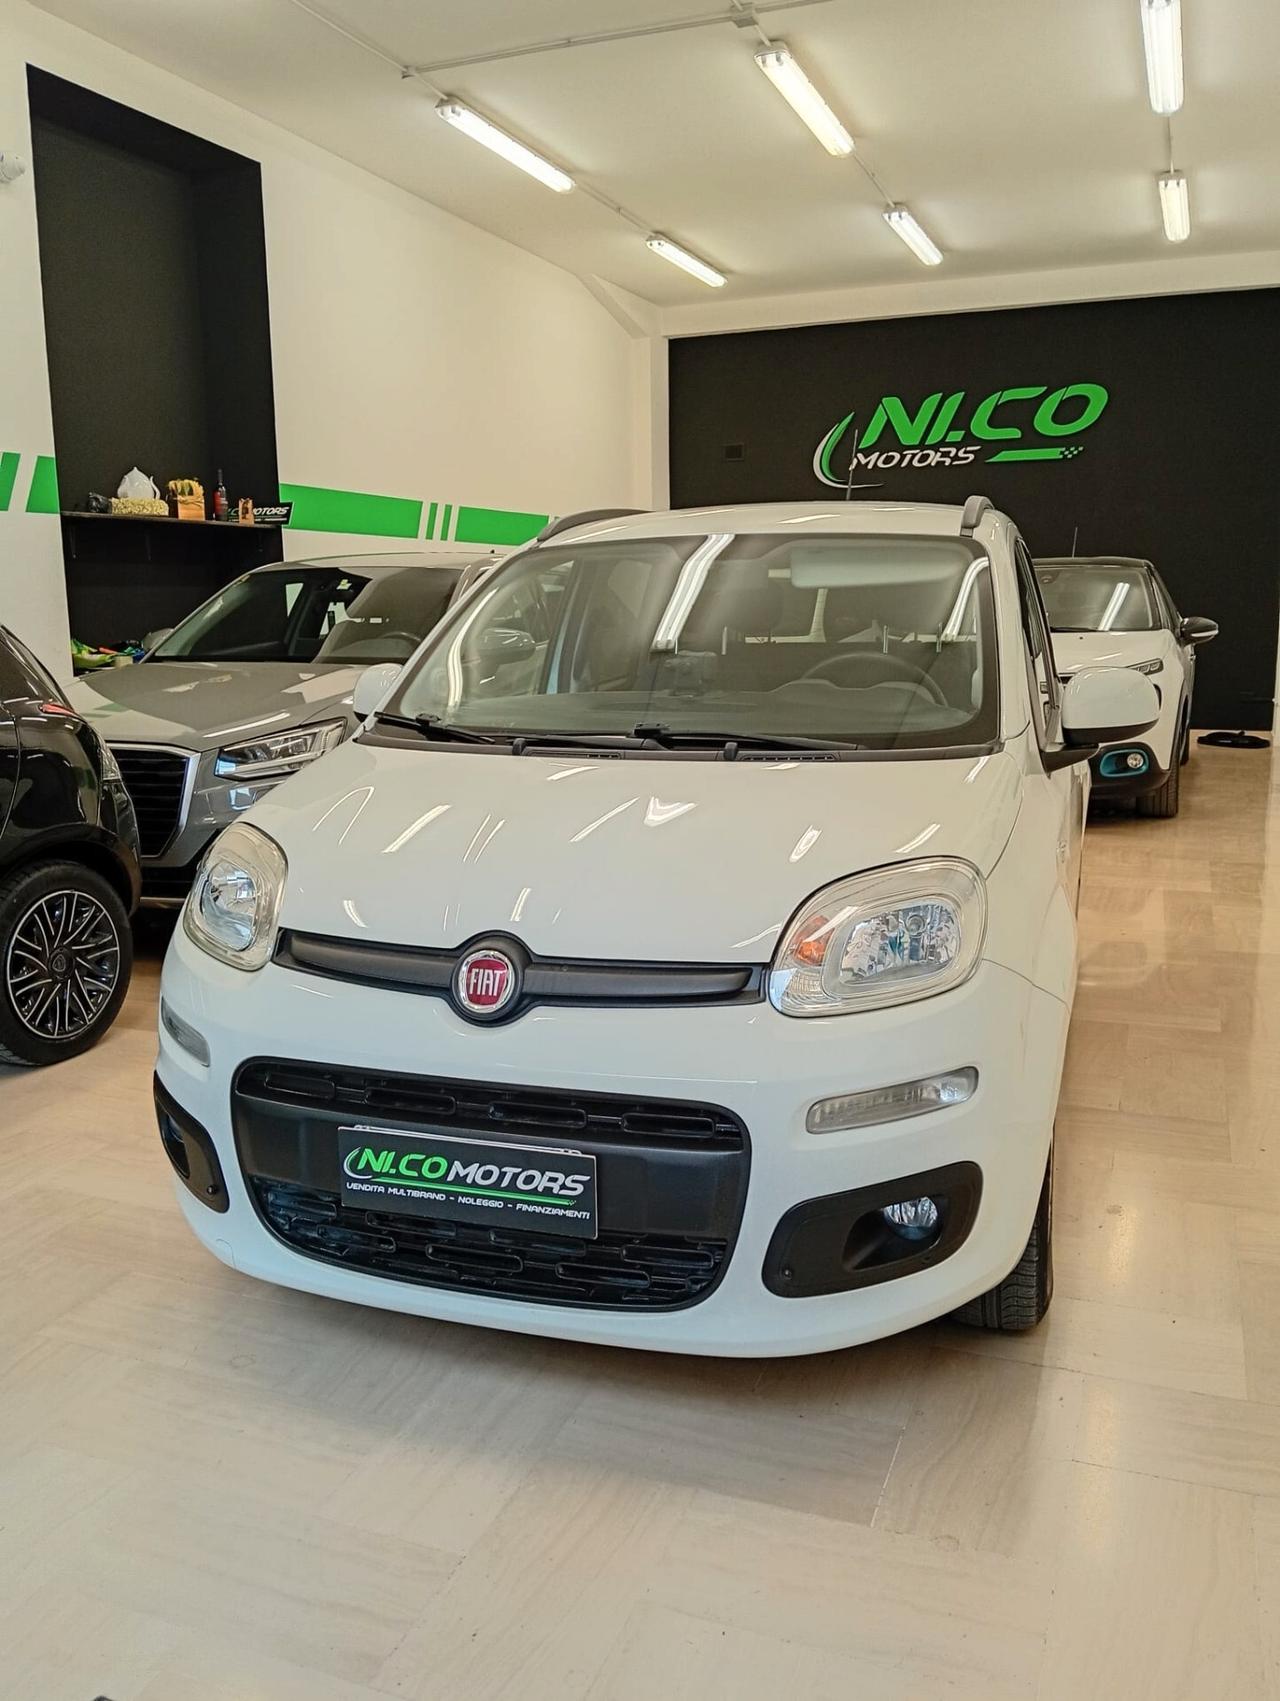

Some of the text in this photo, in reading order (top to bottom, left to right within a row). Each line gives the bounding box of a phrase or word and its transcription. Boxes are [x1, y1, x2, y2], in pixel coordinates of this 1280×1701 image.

[858, 383, 1109, 449] NI.CO
[849, 446, 982, 471] MOTORS
[469, 968, 507, 997] FIAT
[356, 1148, 591, 1196] NI.CO MOTORS
[346, 1182, 385, 1194] VENDITA
[387, 1187, 446, 1201] MULTIBRAND
[458, 1196, 504, 1209] NOLEGGIO
[516, 1203, 590, 1219] FINANZIAMENTI
